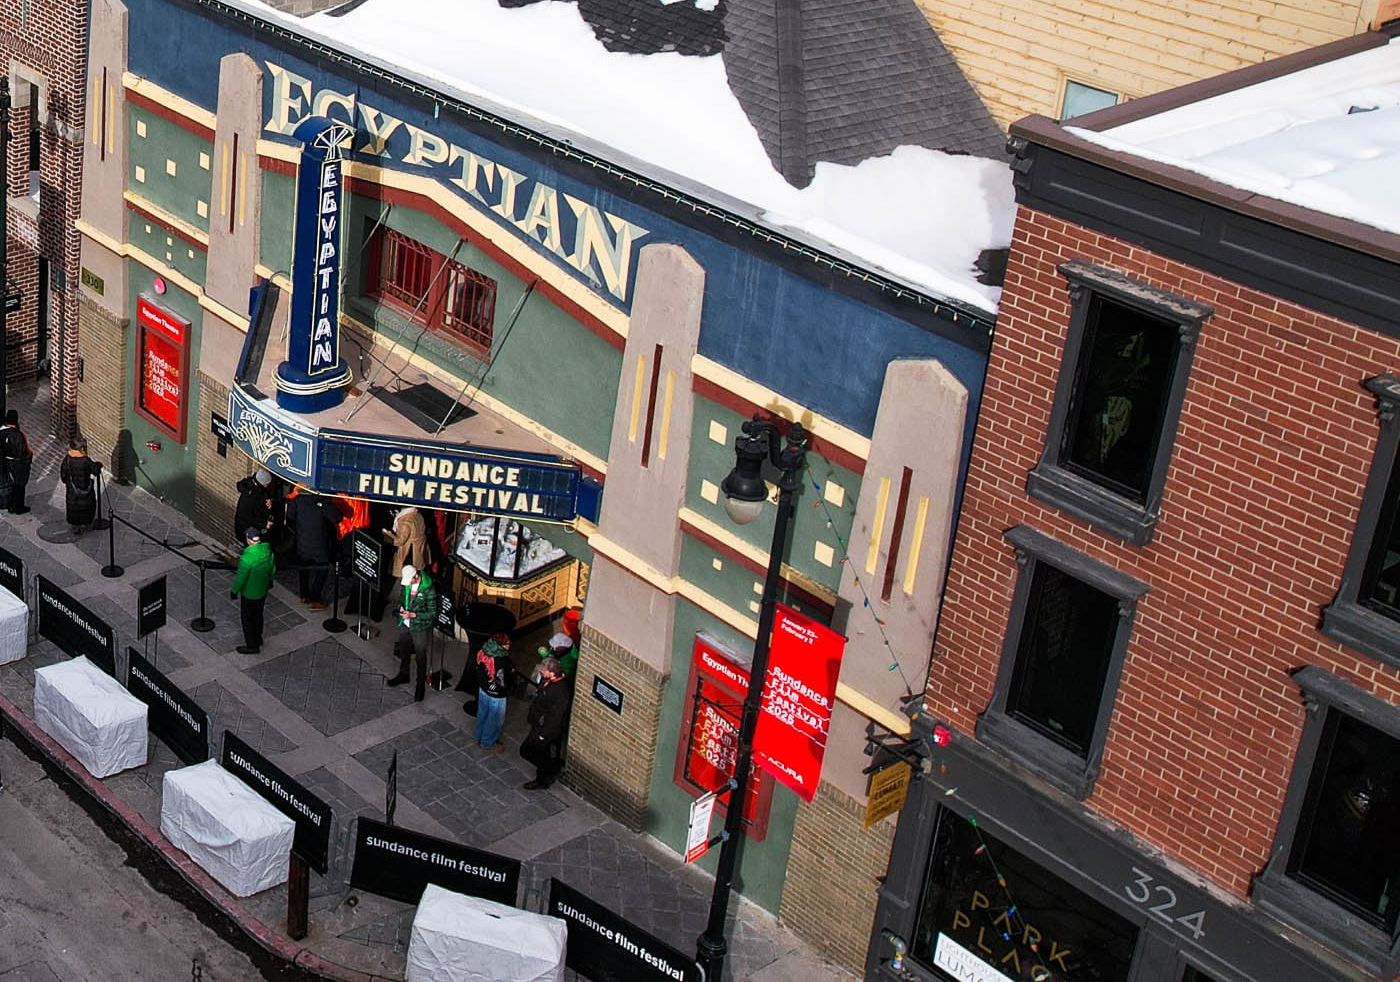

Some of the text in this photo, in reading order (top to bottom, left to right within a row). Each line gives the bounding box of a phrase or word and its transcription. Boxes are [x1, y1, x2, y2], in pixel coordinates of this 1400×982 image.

[86, 274, 98, 290] 330
[312, 165, 339, 366] EGYPTIAN
[240, 410, 293, 453] EGYPTIAN
[389, 453, 520, 487] SUNDANCE
[359, 473, 543, 514] FILM FESTIVAL
[42, 591, 107, 647] sundance film festival
[702, 652, 737, 681] Egyptian
[774, 666, 828, 706] Sundance
[132, 666, 201, 733] sundance film festival
[769, 689, 823, 730] Festival
[772, 678, 799, 703] Film
[704, 720, 732, 745] Film
[700, 745, 726, 770] 2025
[767, 757, 804, 785] ACURA
[230, 750, 322, 827] sundance film festival
[366, 835, 507, 884] sundance film festival
[1124, 866, 1207, 940] 324
[557, 900, 684, 982] sundance film festival
